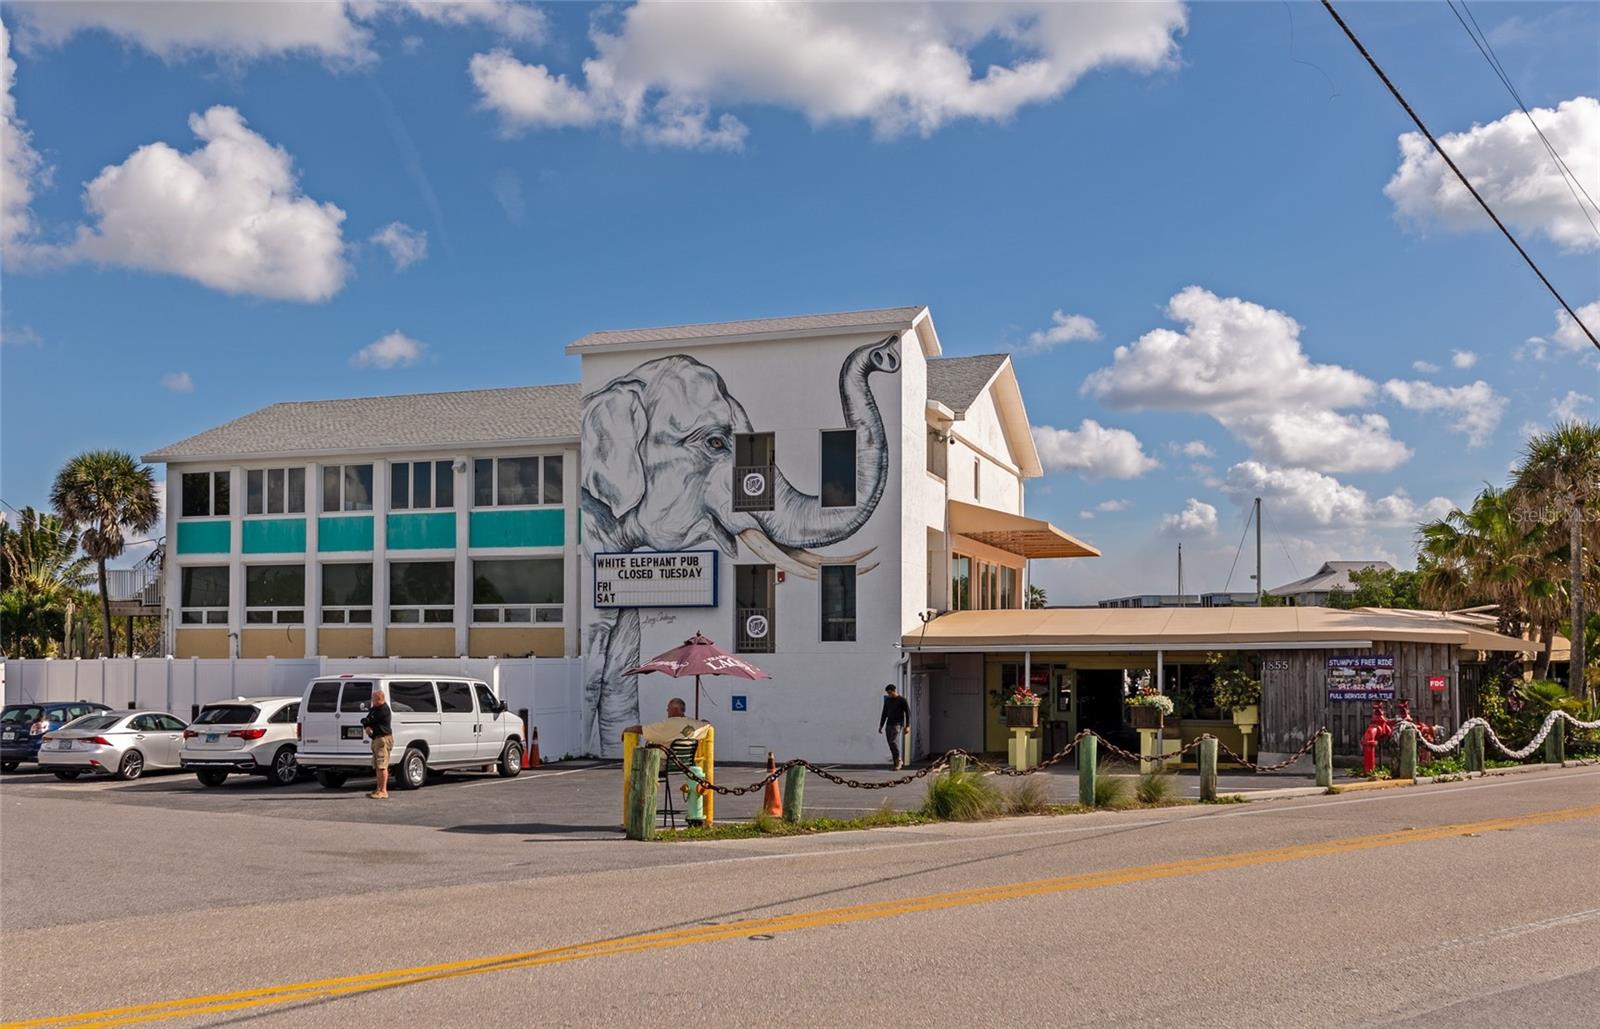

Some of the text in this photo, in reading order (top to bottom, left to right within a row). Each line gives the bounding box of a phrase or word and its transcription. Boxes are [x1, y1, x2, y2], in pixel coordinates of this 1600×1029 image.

[597, 556, 699, 569] WHITE ELEPHANT PUB
[618, 567, 702, 580] CLOSED TUESDAY
[597, 581, 612, 592] FRI
[597, 593, 616, 604] SAT
[1360, 658, 1376, 666] FREE
[1377, 658, 1393, 666] RIDE
[1329, 692, 1393, 700] FULL SERVICE SHUTTLE
